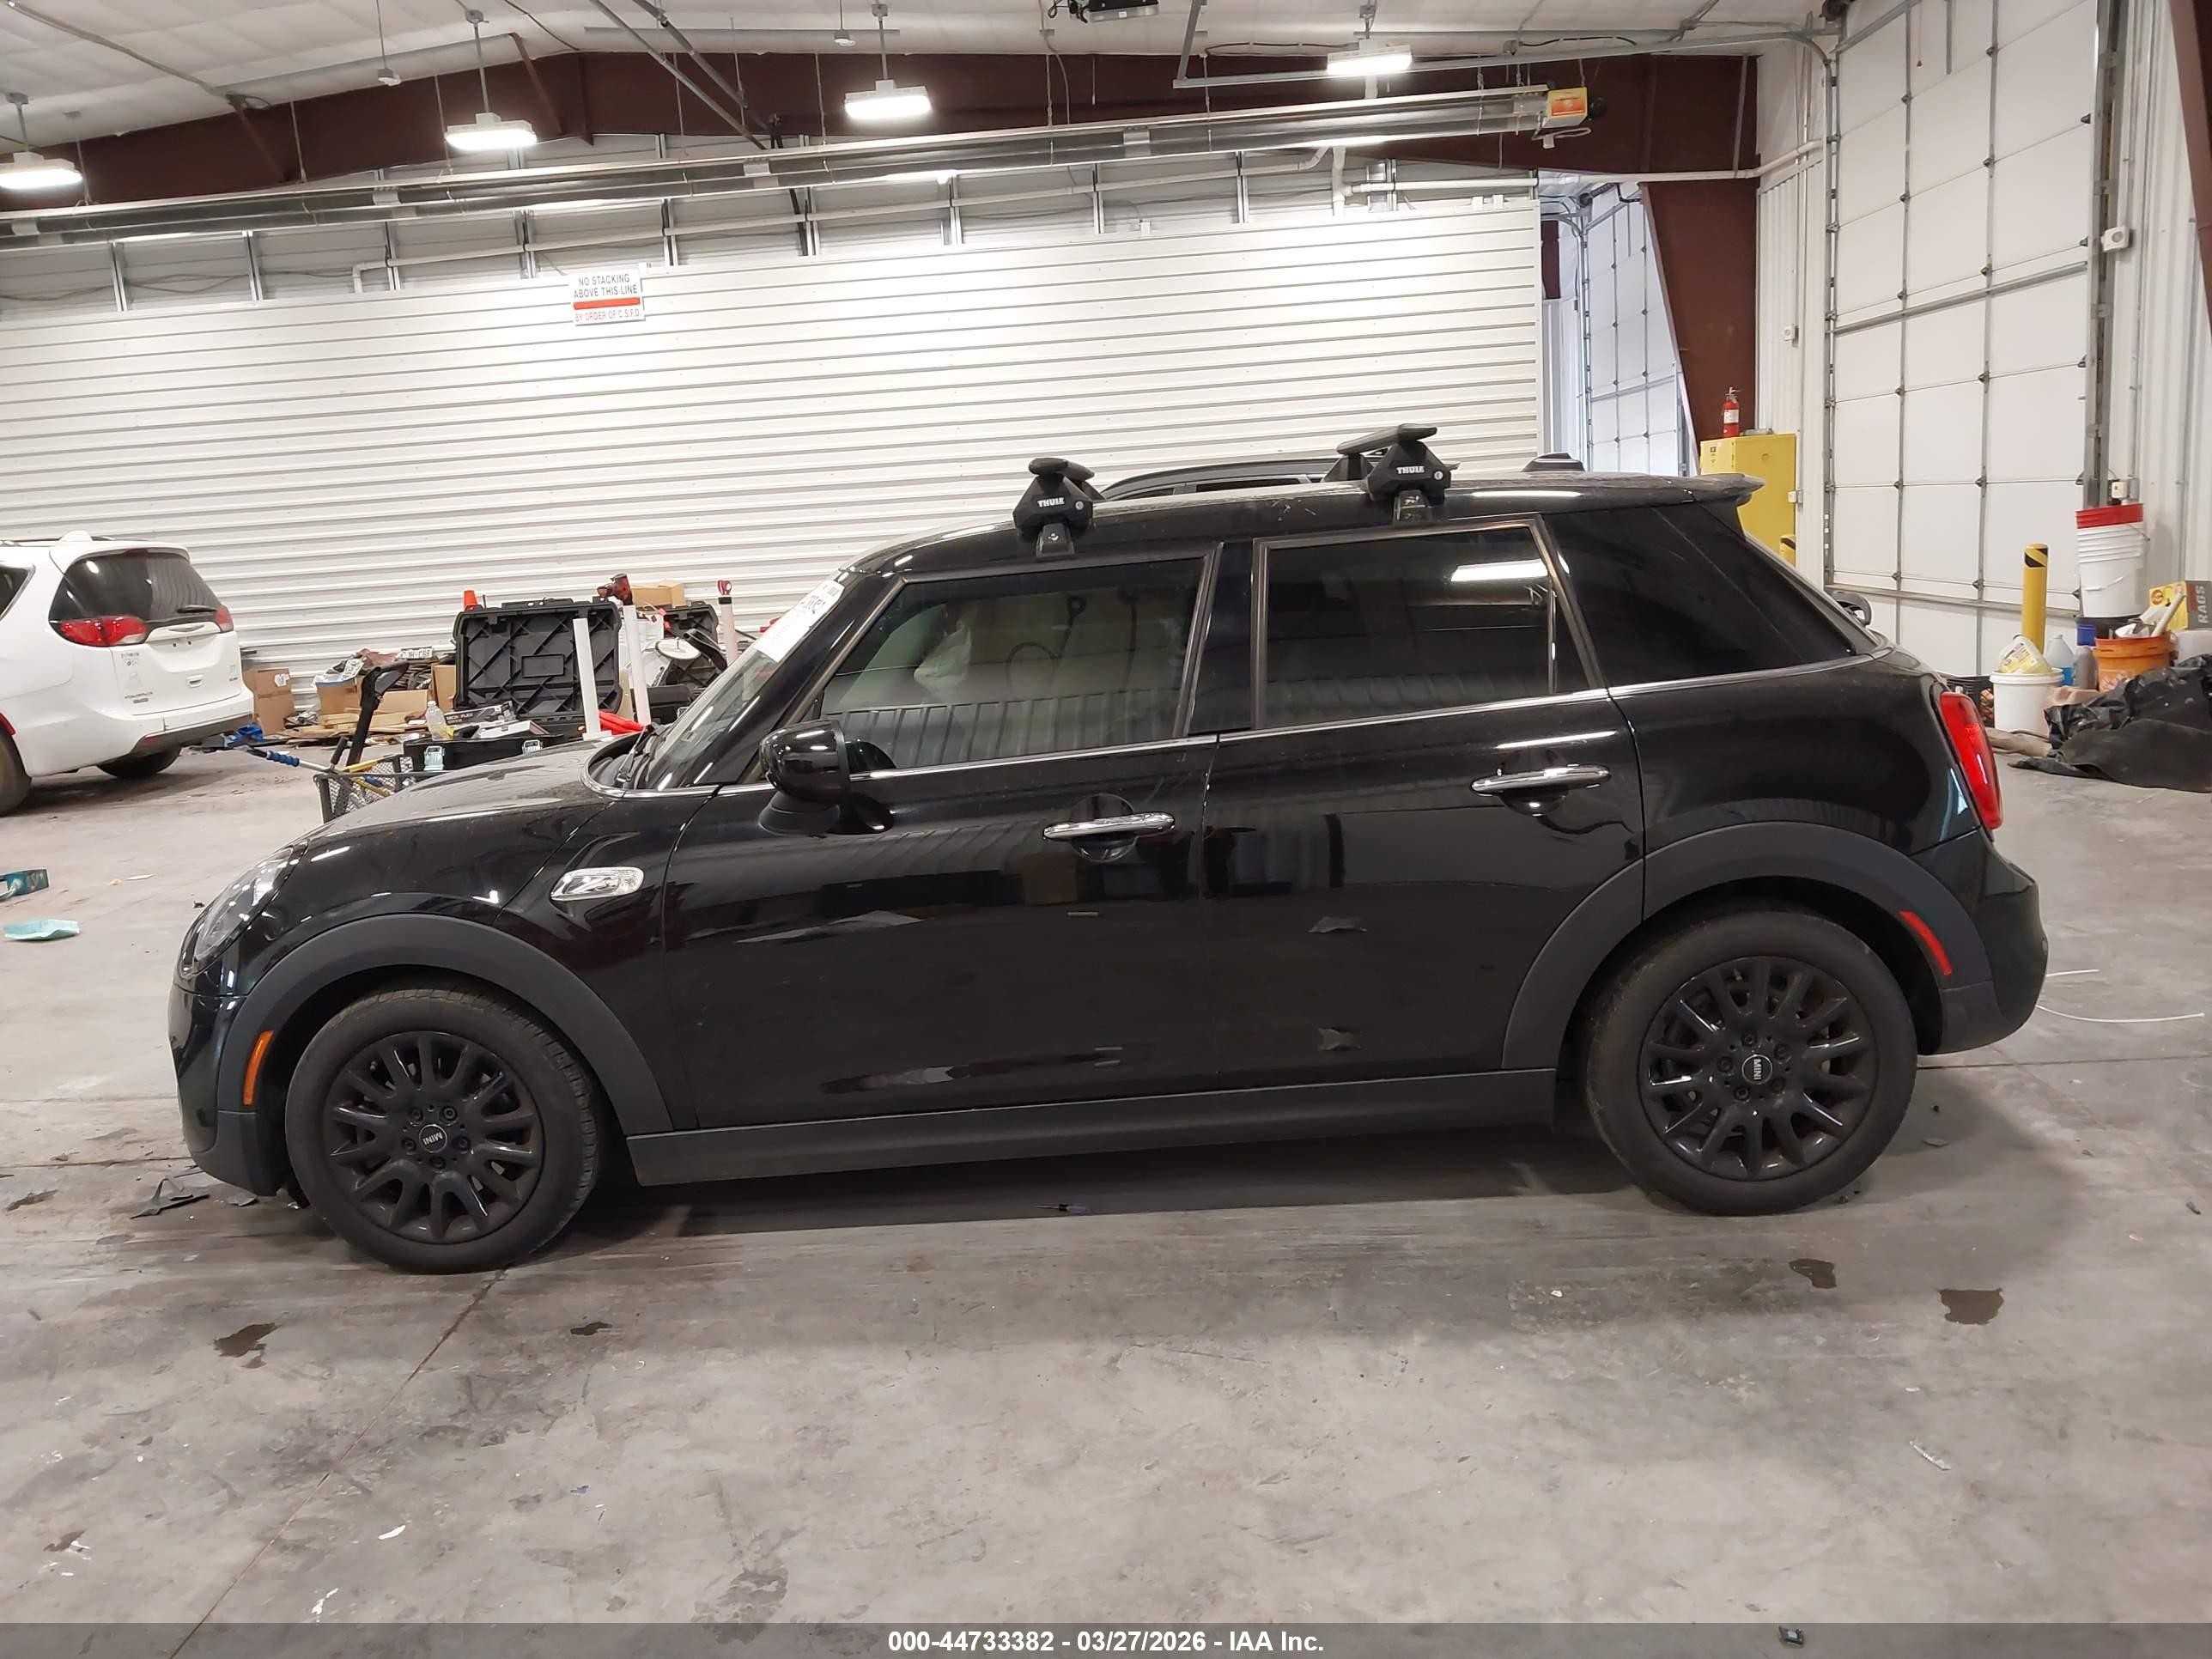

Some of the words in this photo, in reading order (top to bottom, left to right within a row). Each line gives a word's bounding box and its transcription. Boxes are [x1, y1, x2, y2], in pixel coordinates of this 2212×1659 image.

[579, 276, 589, 286] NO
[592, 273, 630, 285] STACKING
[574, 288, 599, 298] ABOVE
[601, 286, 618, 296] THIS
[621, 284, 638, 295] LINE
[585, 310, 606, 321] ORDER
[608, 309, 617, 319] OF
[1396, 465, 1425, 475] THULE
[1036, 497, 1065, 507] THULE
[2195, 585, 2209, 623] RAGS
[1753, 1059, 1762, 1080] MINI
[422, 1132, 443, 1146] MINI
